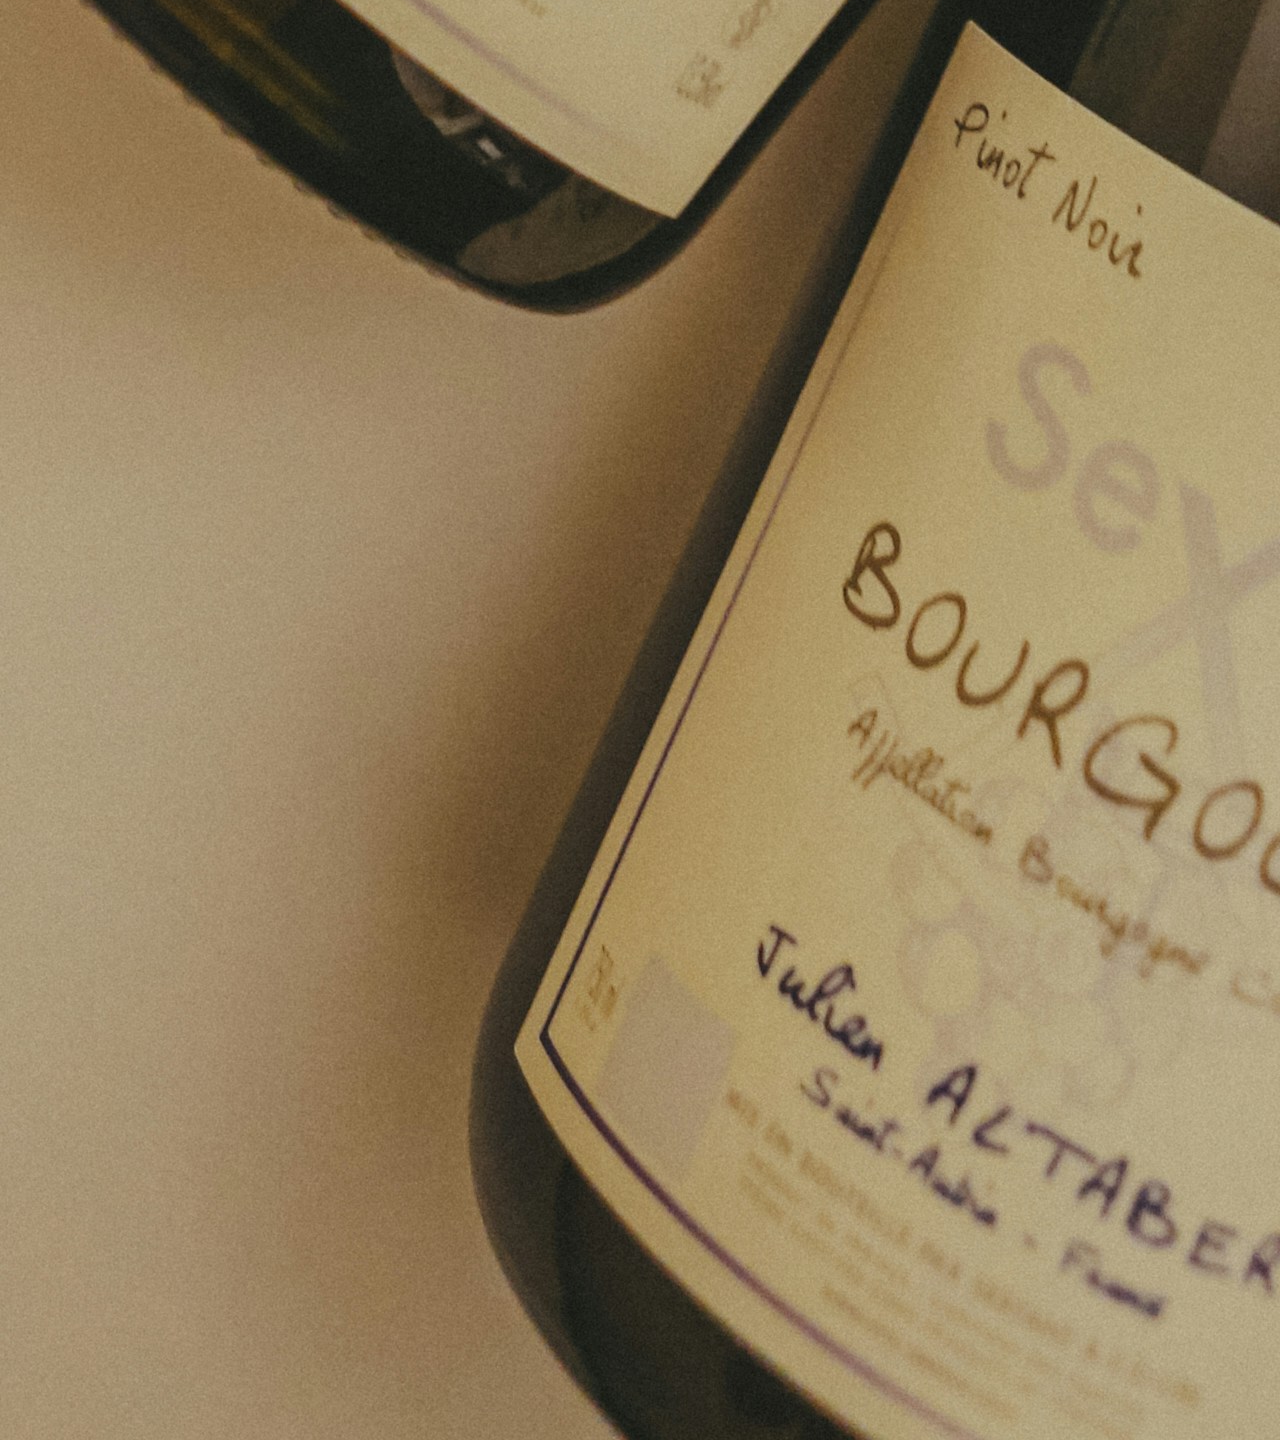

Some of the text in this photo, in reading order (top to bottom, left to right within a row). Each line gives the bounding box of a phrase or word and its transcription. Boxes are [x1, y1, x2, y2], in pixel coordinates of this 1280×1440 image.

[954, 101, 1141, 278] Pinot Noir
[757, 925, 880, 1070] Julien
